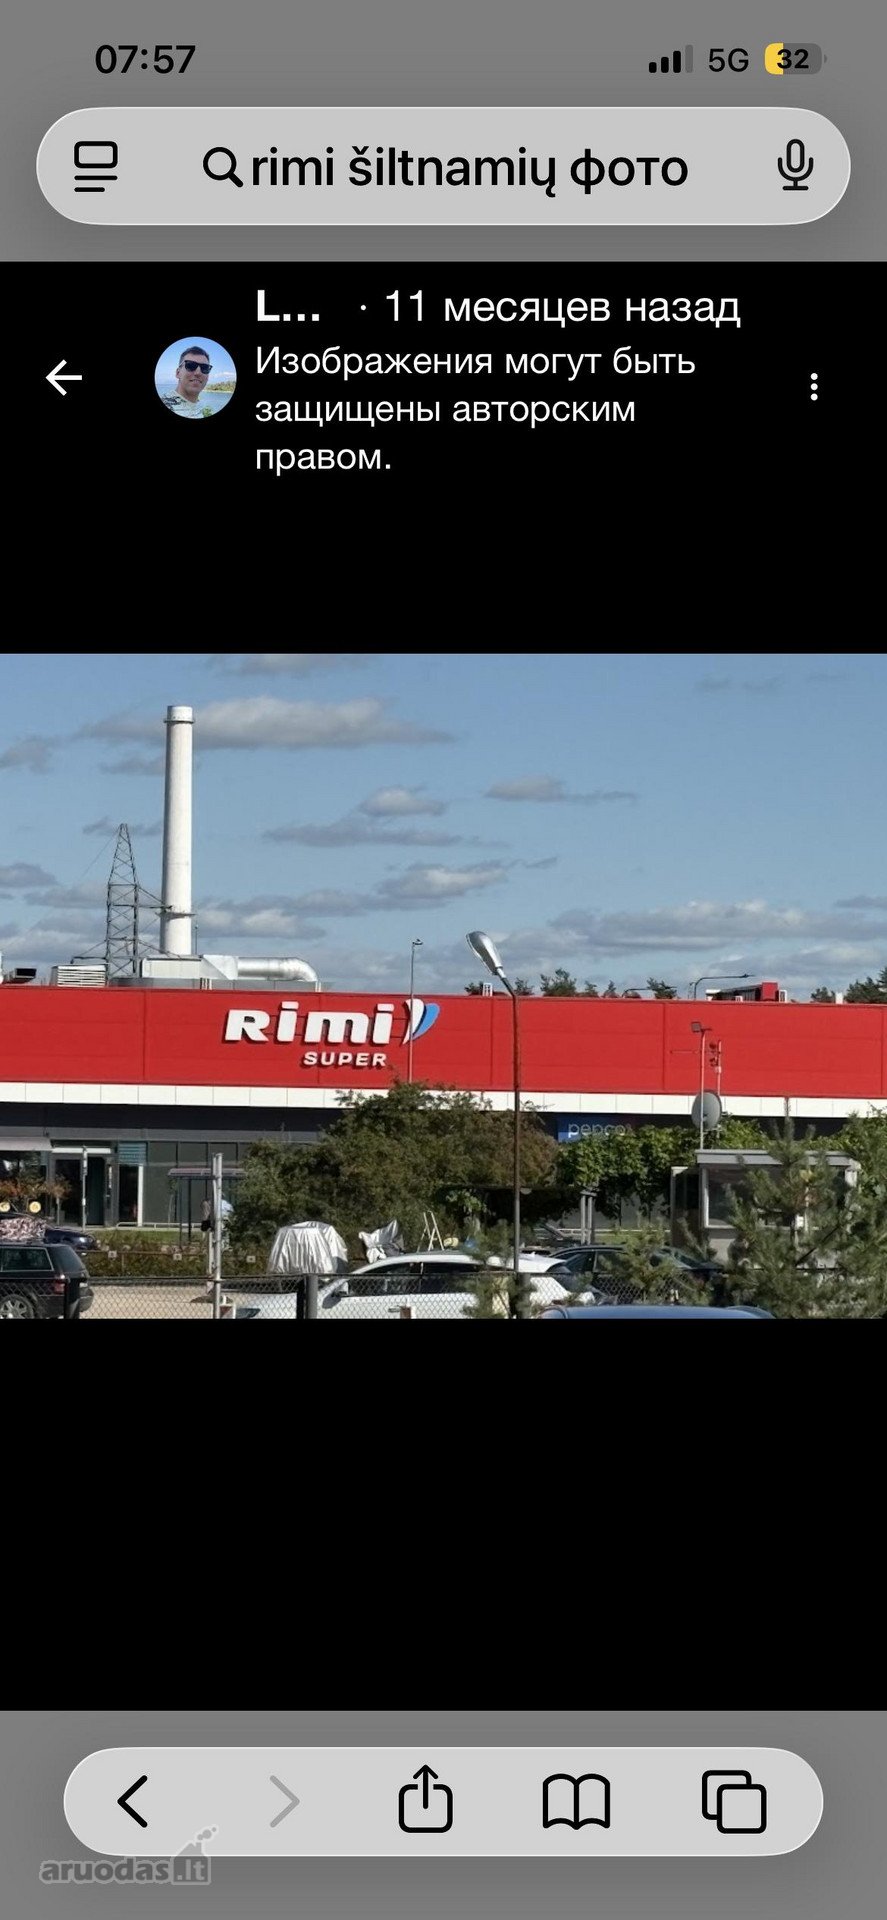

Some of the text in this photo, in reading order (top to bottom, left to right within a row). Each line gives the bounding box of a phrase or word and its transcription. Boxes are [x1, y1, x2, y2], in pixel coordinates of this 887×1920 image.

[96, 45, 195, 74] 07:57
[708, 47, 749, 73] 5G
[777, 48, 810, 70] 32
[252, 145, 689, 198] rimi šiltnamių фото
[386, 289, 423, 322] 11
[444, 297, 611, 329] месяцев
[626, 297, 741, 329] назад
[257, 345, 696, 382] Изображения могут быть
[256, 400, 635, 429] защищены авторским
[256, 448, 391, 477] правом.
[303, 1051, 388, 1067] SUPER
